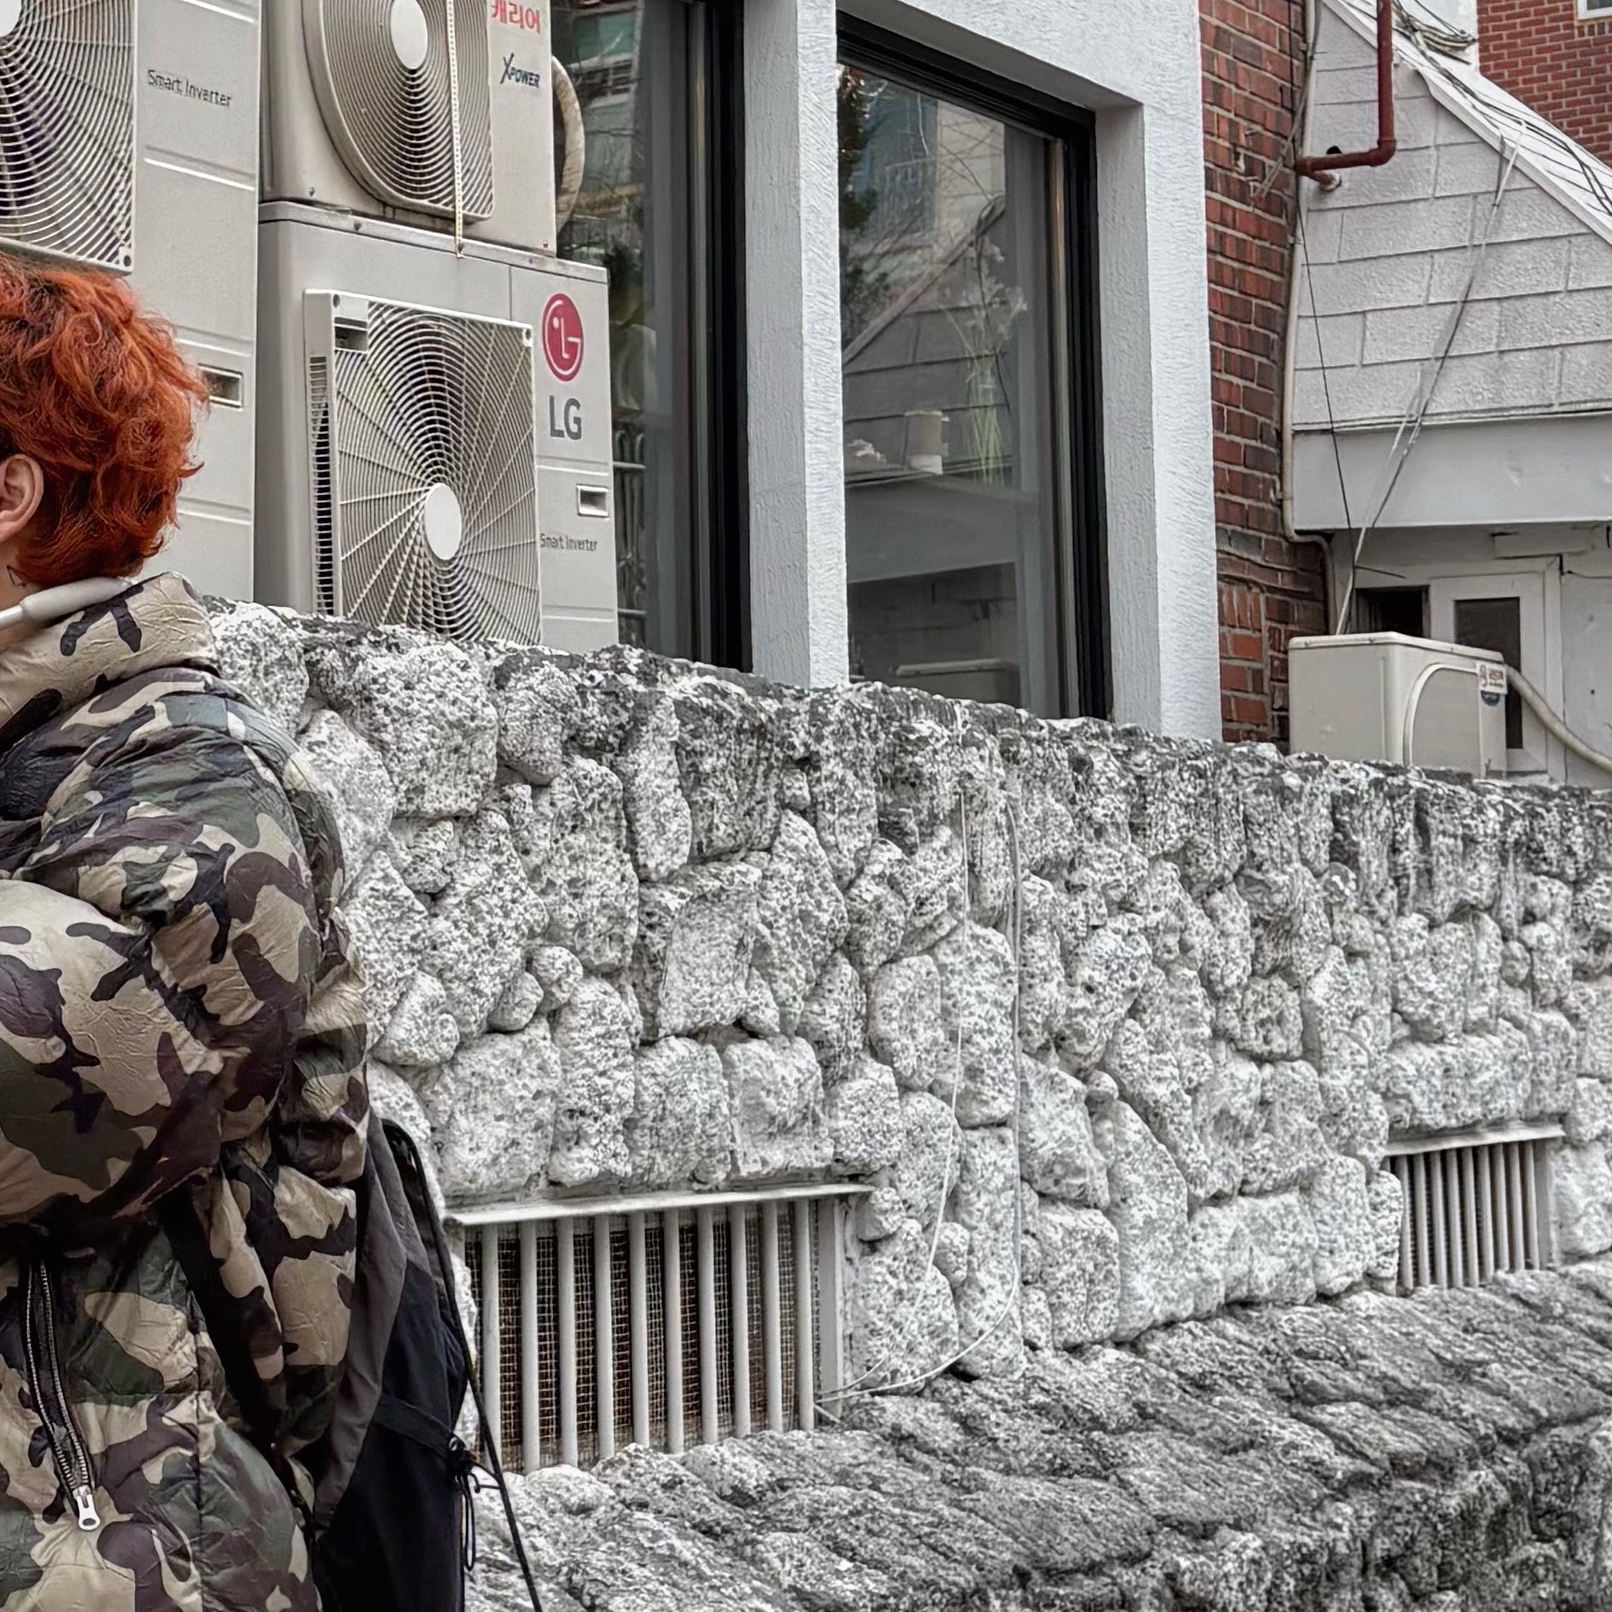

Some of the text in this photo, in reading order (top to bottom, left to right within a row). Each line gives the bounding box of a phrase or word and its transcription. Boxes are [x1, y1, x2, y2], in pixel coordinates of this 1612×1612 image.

[491, 0, 540, 34] 캐리어
[148, 69, 232, 108] Smart Inverter
[548, 394, 583, 441] LG
